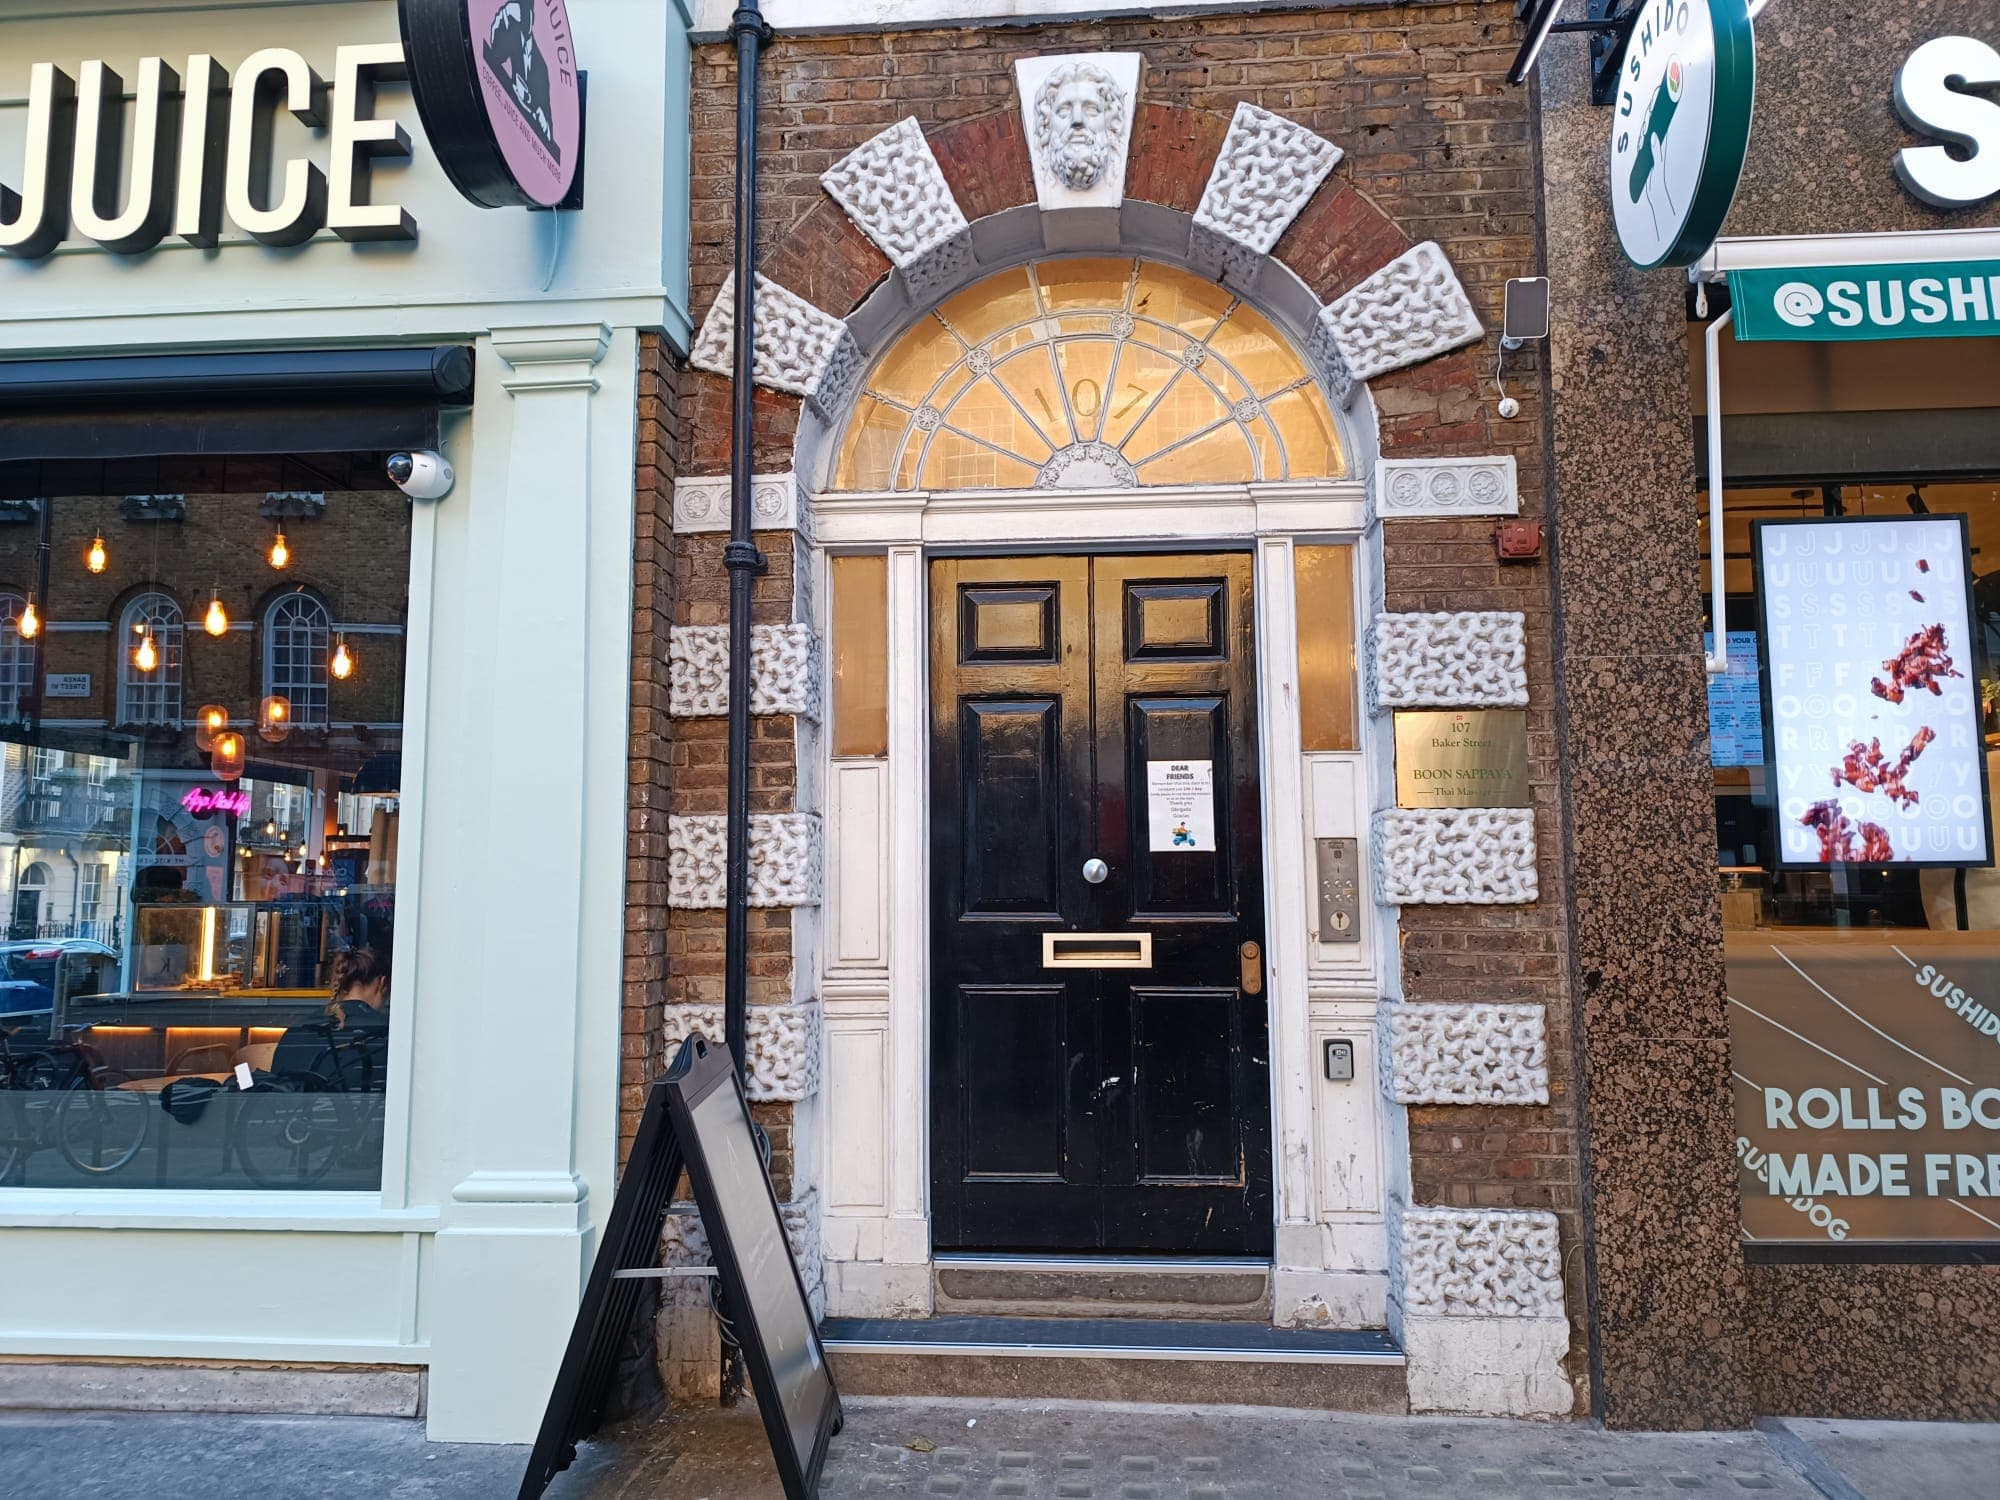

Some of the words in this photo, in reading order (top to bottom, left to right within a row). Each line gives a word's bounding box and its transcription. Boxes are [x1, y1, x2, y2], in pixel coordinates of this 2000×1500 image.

[0, 43, 408, 247] JUICE
[1034, 379, 1149, 422] 107
[1432, 738, 1461, 748] Baker
[1463, 738, 1492, 748] Street
[1451, 722, 1471, 733] 107
[1414, 769, 1453, 780] BOON
[1455, 769, 1512, 780] SAPPAYA
[1434, 788, 1455, 796] Thai
[1458, 788, 1491, 798] Masge
[1916, 965, 2000, 1045] SUSHID
[1765, 1087, 1928, 1130] ROLLS
[1768, 1153, 1911, 1196] MADE
